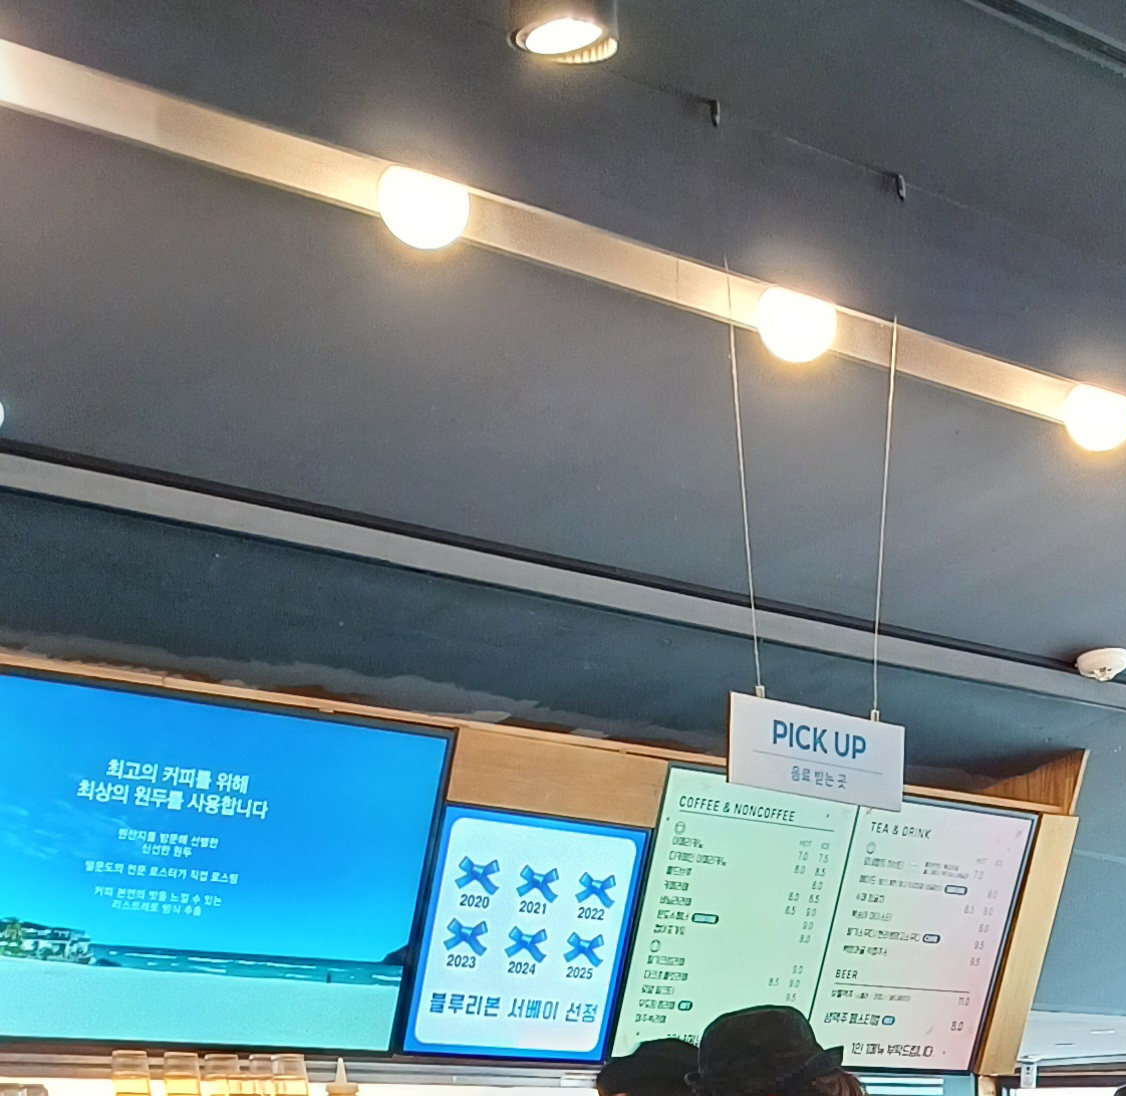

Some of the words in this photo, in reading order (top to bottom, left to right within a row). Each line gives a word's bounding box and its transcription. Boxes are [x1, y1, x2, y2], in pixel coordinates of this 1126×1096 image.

[772, 719, 828, 754] PICK
[834, 731, 867, 759] UP
[106, 758, 159, 783] 최고의
[162, 765, 212, 790] 커피를
[216, 772, 250, 795] 위해
[791, 765, 811, 782] 음료
[814, 771, 834, 787] 받는
[837, 773, 848, 790] 곳
[76, 779, 130, 804] 최상의
[134, 785, 184, 811] 원두를
[187, 793, 269, 820] 사용합니다
[679, 795, 720, 812] COFFEE
[723, 802, 730, 813] &
[734, 803, 795, 822] NONCOFFEE
[871, 821, 889, 834] TEA
[892, 825, 899, 835] &
[902, 826, 932, 839] DRINK
[459, 893, 490, 909] 2020
[518, 900, 548, 915] 2021
[577, 906, 605, 921] 2022
[446, 954, 477, 969] 2023
[508, 961, 536, 976] 2024
[566, 965, 593, 980] 2025
[835, 969, 858, 979] BEER
[429, 992, 501, 1018] 블루리본
[507, 997, 560, 1021] 서베이
[565, 1002, 599, 1024] 선정
